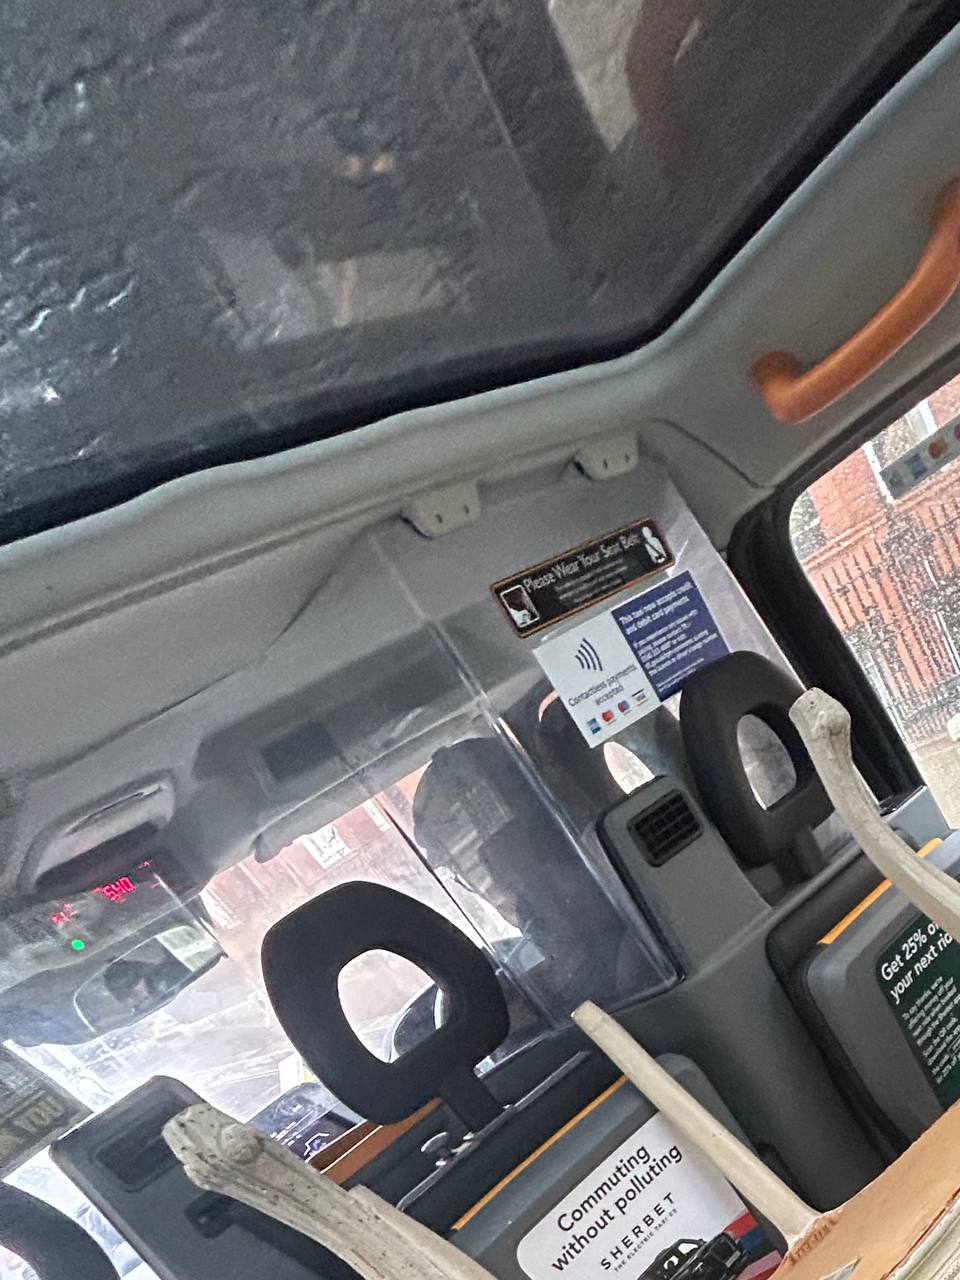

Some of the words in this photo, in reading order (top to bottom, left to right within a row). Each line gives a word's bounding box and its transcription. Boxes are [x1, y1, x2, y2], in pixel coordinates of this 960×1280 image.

[522, 572, 556, 593] Please
[551, 560, 579, 579] Wear
[576, 551, 601, 568] Your
[567, 680, 607, 707] Contactless
[594, 682, 624, 706] accepted
[880, 954, 904, 980] Get
[901, 928, 927, 960] 25%
[890, 970, 913, 1005] your
[913, 944, 938, 975] next
[551, 1209, 615, 1271] without
[614, 1145, 682, 1215] polluting
[557, 1146, 650, 1231] Commuting
[600, 1192, 673, 1270] SHERBET
[613, 1259, 626, 1272] THE
[626, 1231, 654, 1260] ELECTRIC
[653, 1216, 668, 1231] TAXI
